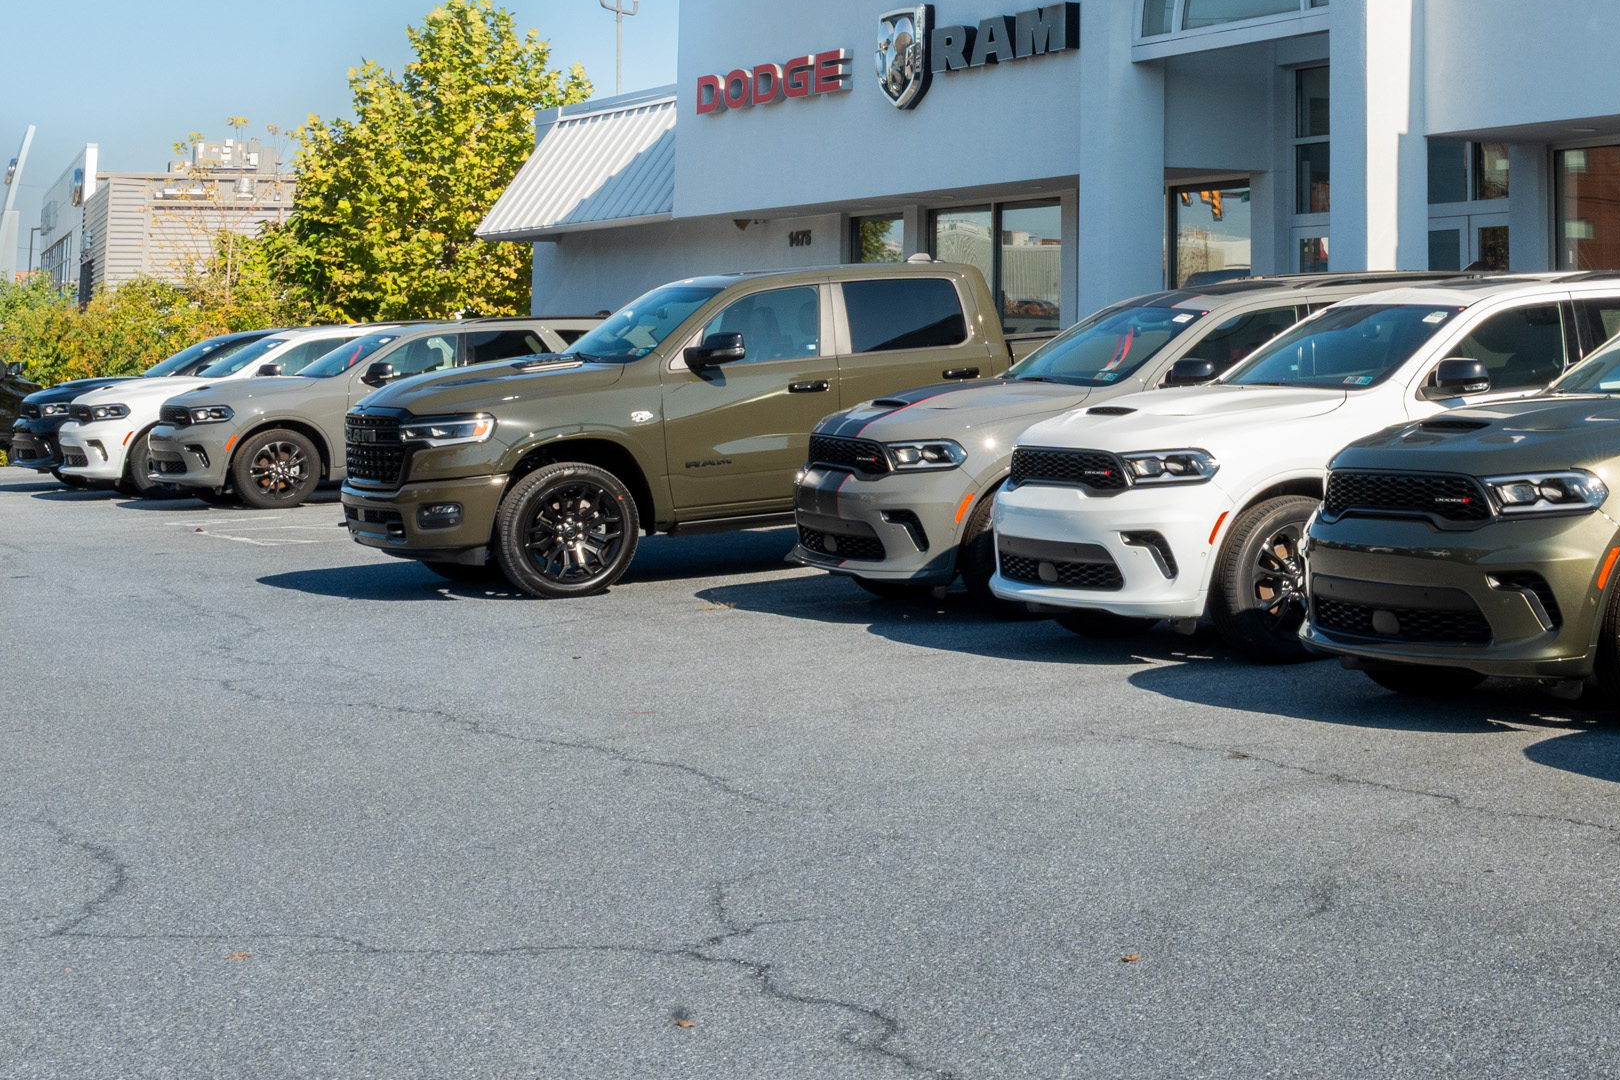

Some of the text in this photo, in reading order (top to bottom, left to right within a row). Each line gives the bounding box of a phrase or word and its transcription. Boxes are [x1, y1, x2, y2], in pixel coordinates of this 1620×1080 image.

[930, 1, 1080, 74] RAM
[696, 47, 852, 115] DODGE
[788, 229, 812, 248] 1475
[345, 428, 376, 442] RAM
[685, 458, 732, 469] RAM
